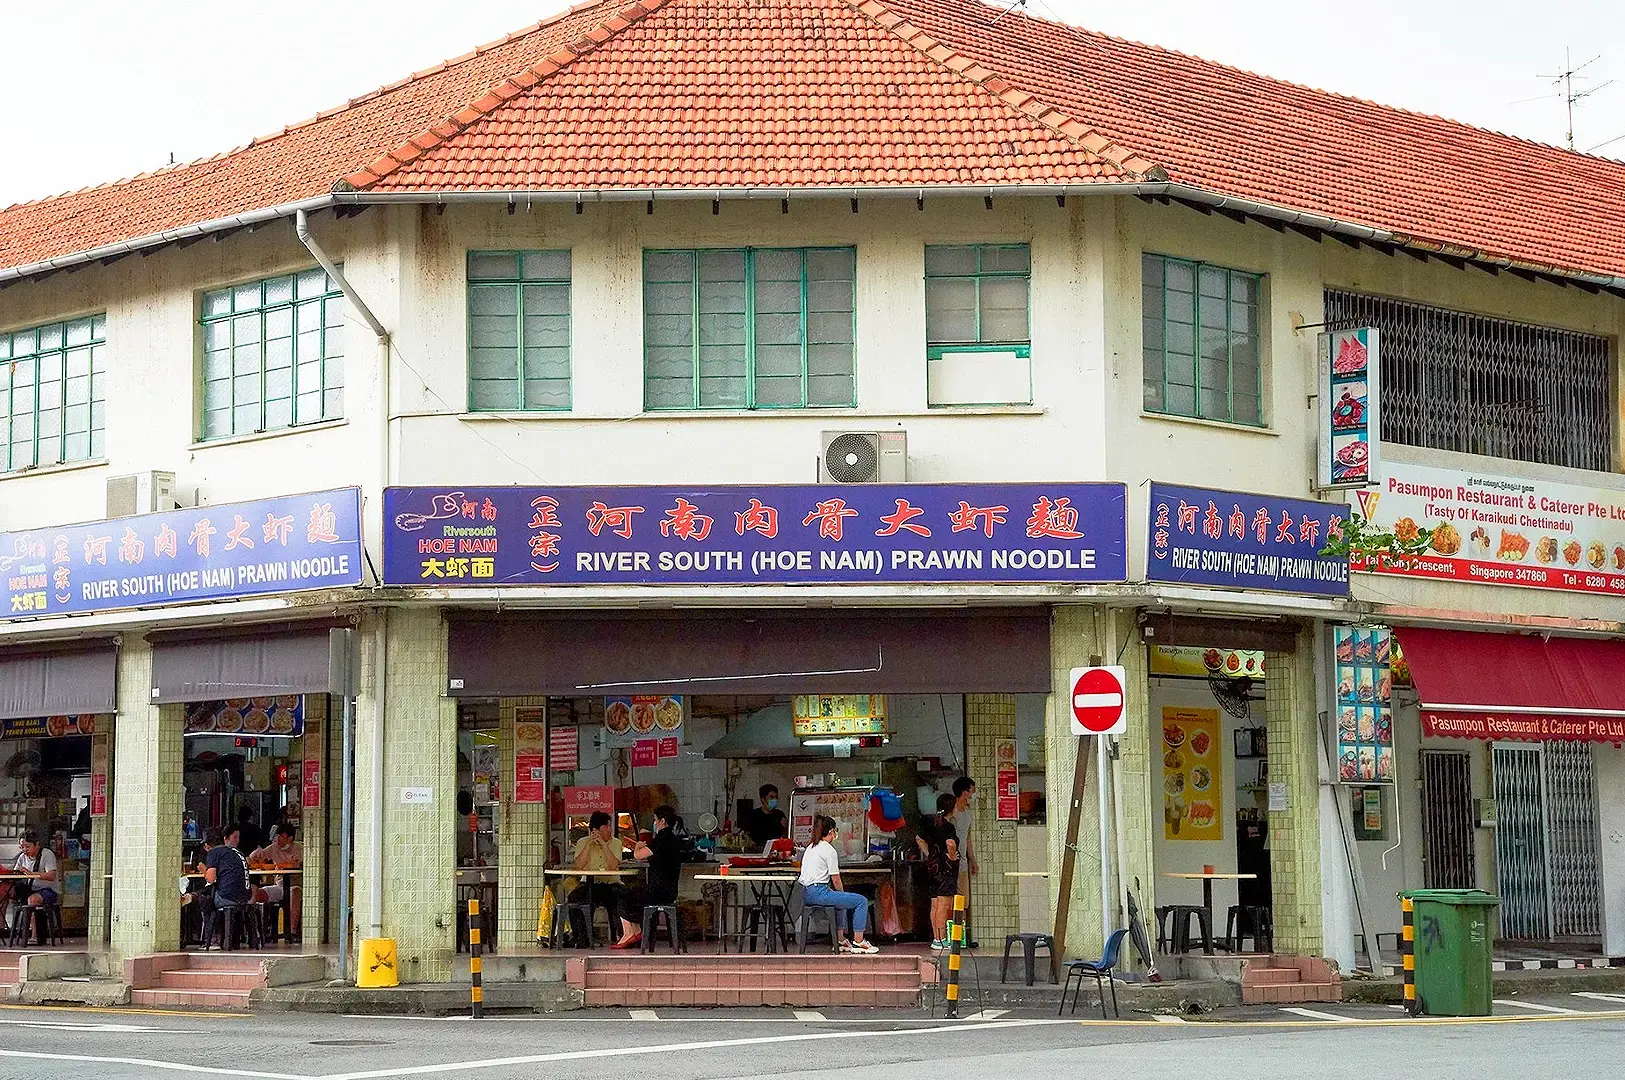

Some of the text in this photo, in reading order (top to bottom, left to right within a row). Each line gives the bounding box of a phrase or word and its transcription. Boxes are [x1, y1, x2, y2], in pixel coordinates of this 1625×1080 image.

[1388, 477, 1453, 502] Pasumpon
[1457, 486, 1524, 508] Restaurant
[1528, 495, 1536, 510] &
[1541, 497, 1584, 515] Caterer
[1588, 503, 1606, 518] Pte
[462, 498, 497, 521] 河南
[1424, 503, 1574, 534] (Tasty Of Karaikudi Chettinadu)
[443, 526, 496, 537] Riversouth
[418, 538, 498, 553] HOE NAM
[421, 557, 495, 578] 大虾面
[576, 549, 1096, 575] RIVER SOUTH (HOE NAM) PRAWN NOODLE
[1172, 548, 1348, 583] RIVER SOUTH (HOE NAM) PRAWN NOODLE
[8, 574, 48, 590] HOE NAM
[82, 554, 349, 600] RIVER SOUTH (HOE NAM) PRAWN NOODLE
[1470, 564, 1514, 580] Singapore
[1515, 568, 1547, 583] 347860
[1585, 575, 1606, 587] 6280
[11, 591, 47, 612] 大虾面
[1430, 714, 1624, 736] Pasumpon Restaurant & Caterer Pte Ltd
